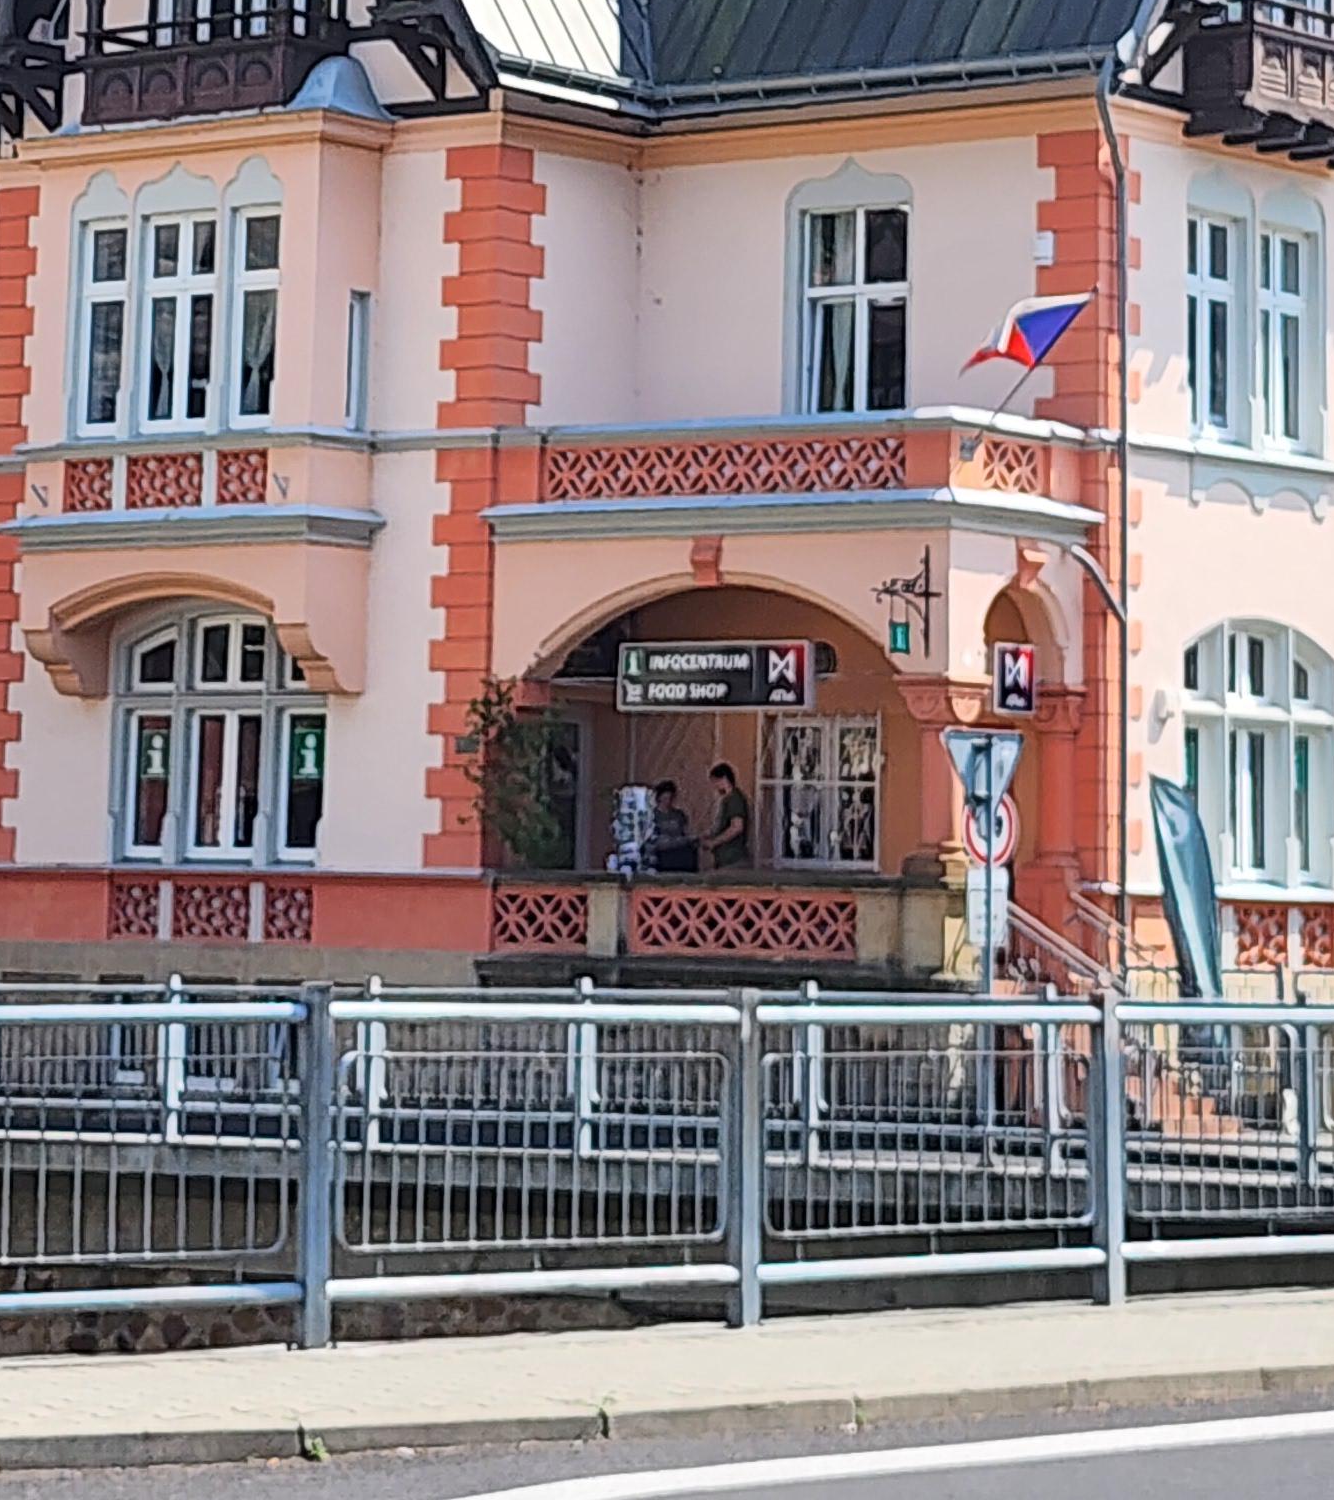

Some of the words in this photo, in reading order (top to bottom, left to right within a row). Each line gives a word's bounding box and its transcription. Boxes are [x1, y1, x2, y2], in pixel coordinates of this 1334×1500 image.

[648, 653, 751, 670] INFOCENTRUM
[648, 682, 687, 700] FOOD
[689, 682, 729, 700] SHOP
